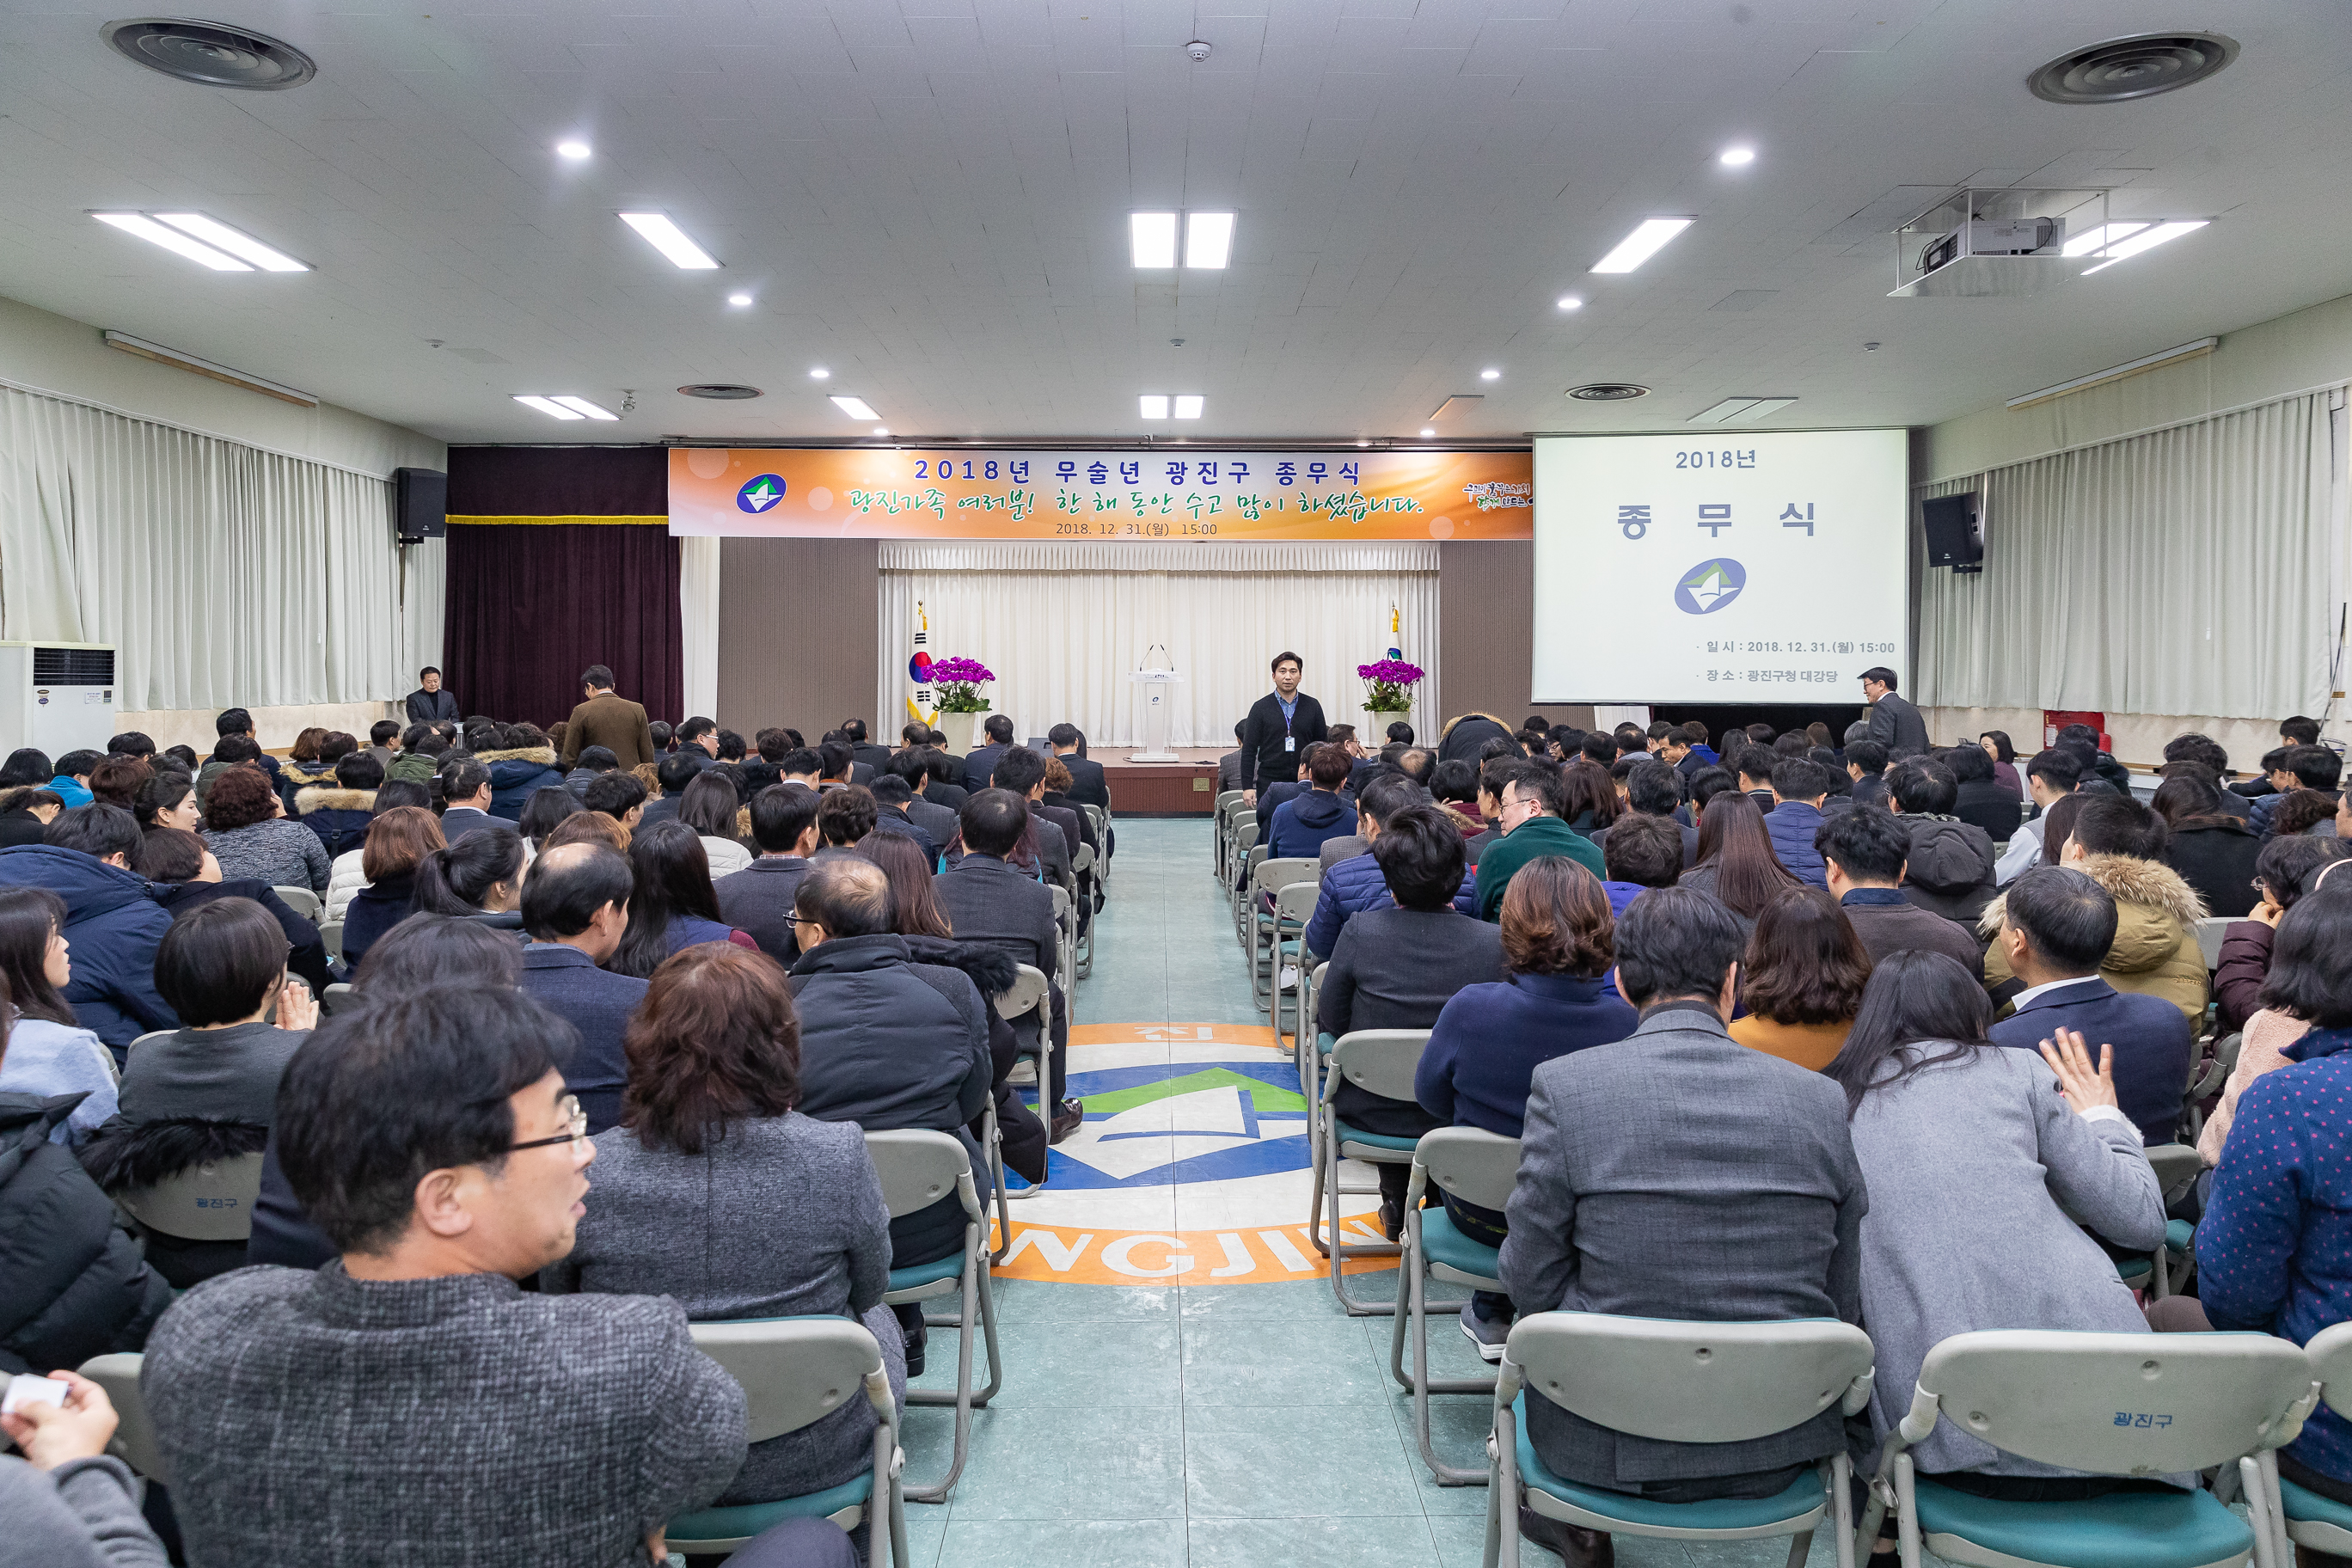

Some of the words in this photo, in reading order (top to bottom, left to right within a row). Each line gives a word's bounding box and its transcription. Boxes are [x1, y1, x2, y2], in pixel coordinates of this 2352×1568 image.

[1675, 449, 1755, 469] 2018년
[915, 460, 1030, 485] 2018년
[1055, 460, 1140, 485] 무술년
[1165, 461, 1251, 486] 광진구
[1275, 462, 1360, 487] 종무식
[850, 488, 945, 519] 광진가족
[958, 490, 1034, 521] 여러분!
[1130, 491, 1174, 517] 동안
[1186, 492, 1223, 520] 수고
[1237, 493, 1284, 521] 많이
[1297, 490, 1424, 523] 하셨습니다.
[1100, 524, 1118, 535] 12.
[1126, 523, 1170, 536] 31.(월)
[1182, 524, 1217, 535] 15:00
[1787, 641, 1807, 652] 12.
[1810, 641, 1854, 654] 31.(월)
[1859, 642, 1896, 653] 15:00
[1747, 670, 1797, 683] 광진구청
[1800, 671, 1839, 683] 대강당
[2112, 1411, 2173, 1430] 광진구
